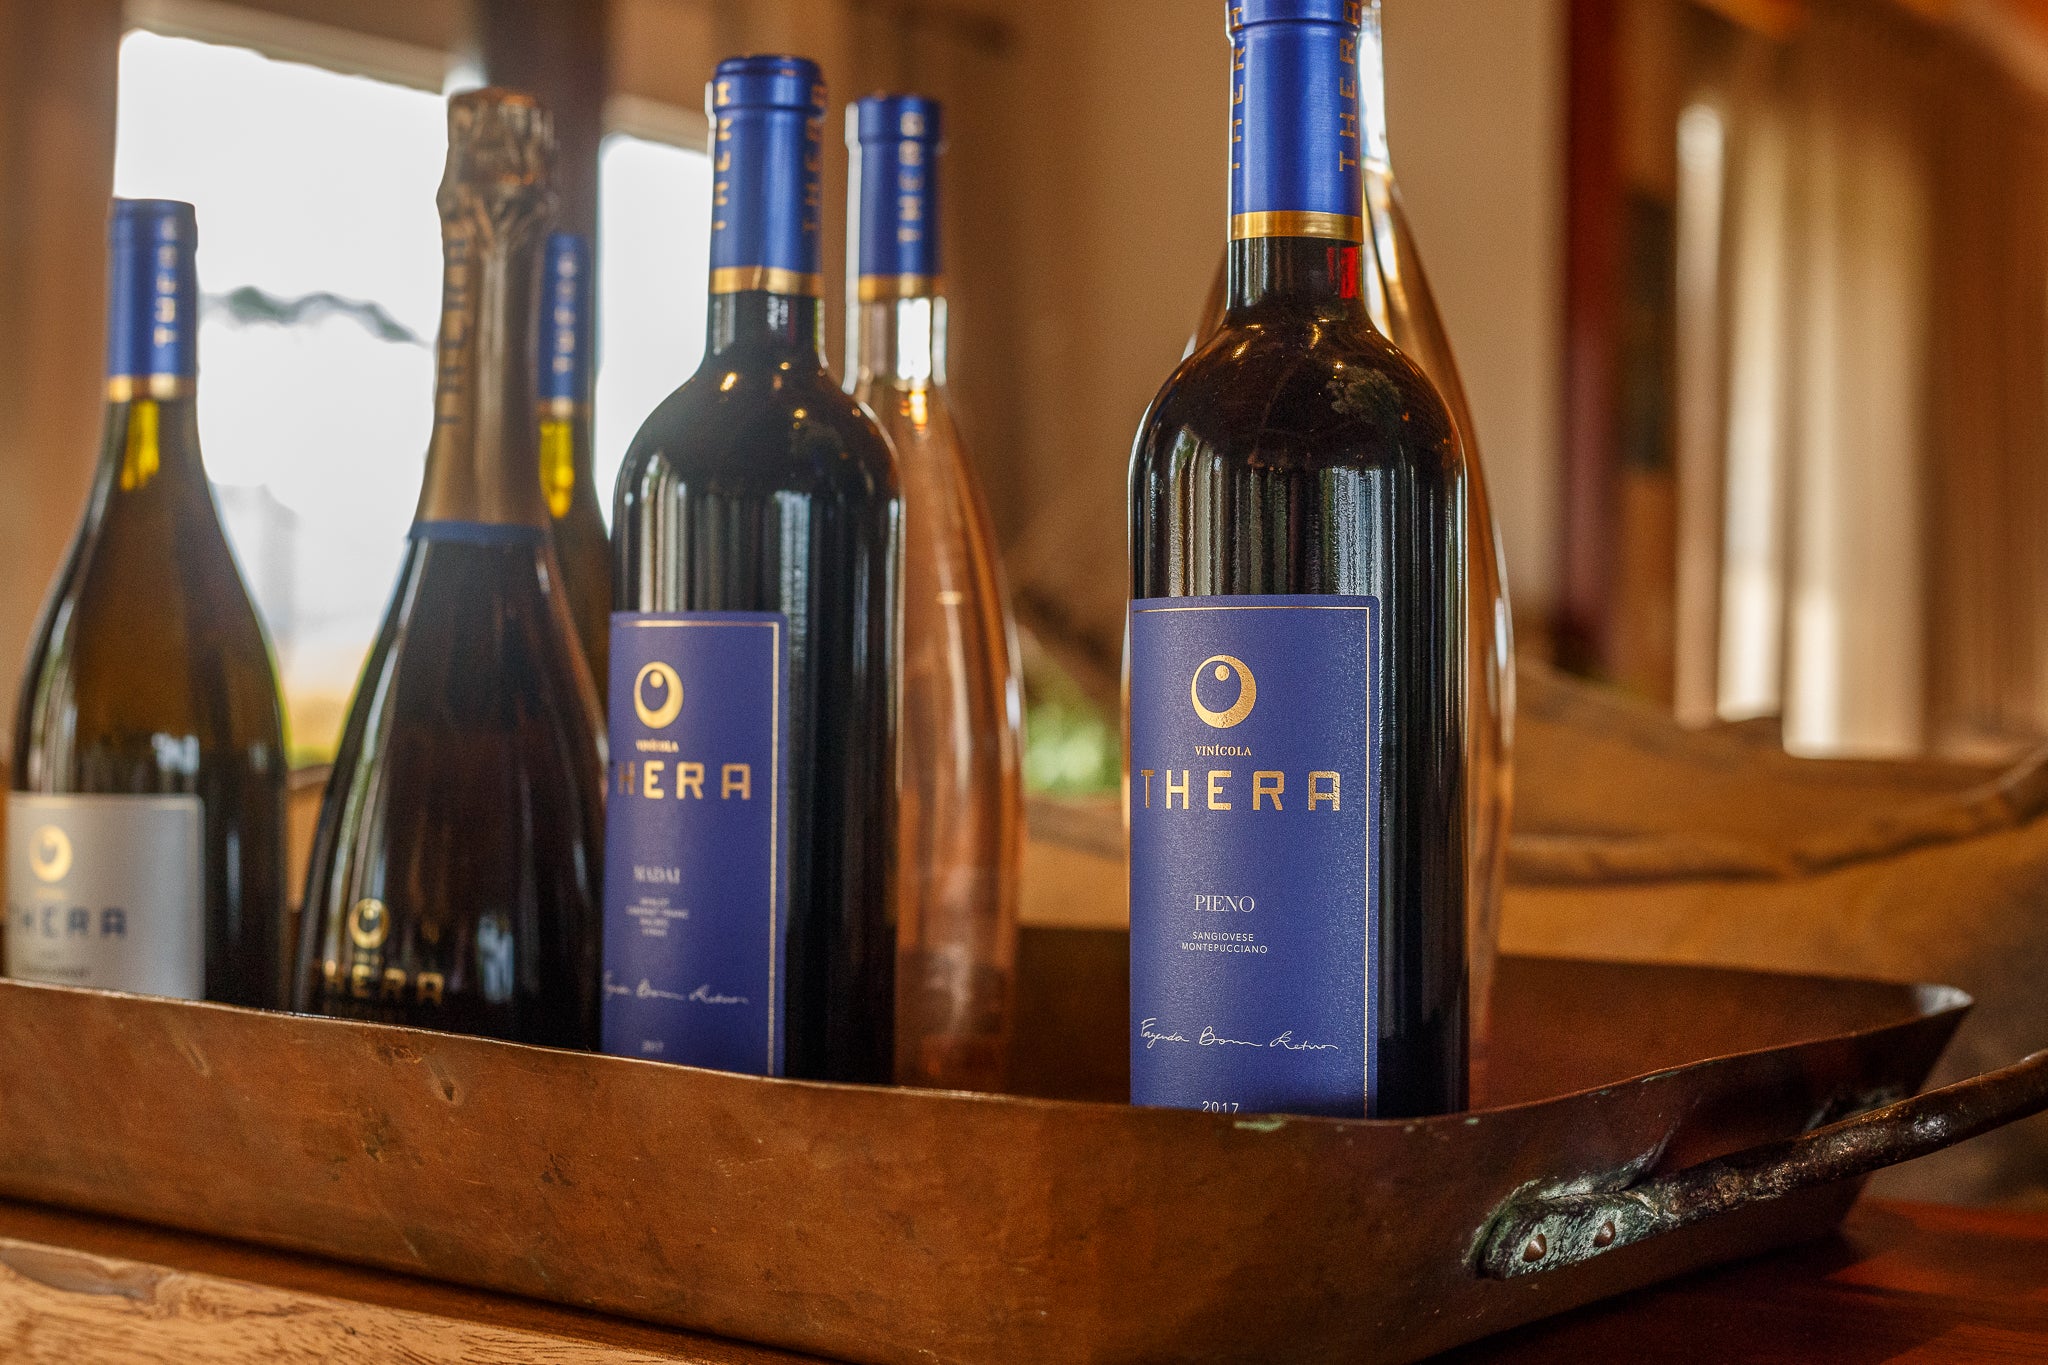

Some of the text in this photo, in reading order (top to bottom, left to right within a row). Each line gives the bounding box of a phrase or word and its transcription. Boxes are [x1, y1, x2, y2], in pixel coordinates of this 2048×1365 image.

[1194, 744, 1252, 757] VINÍCOLA
[1140, 769, 1341, 812] THERA
[1193, 894, 1255, 913] PIENO
[1192, 931, 1254, 942] SANGIOVESE
[1198, 1025, 1263, 1047] Bom
[1202, 1101, 1239, 1114] 2017
